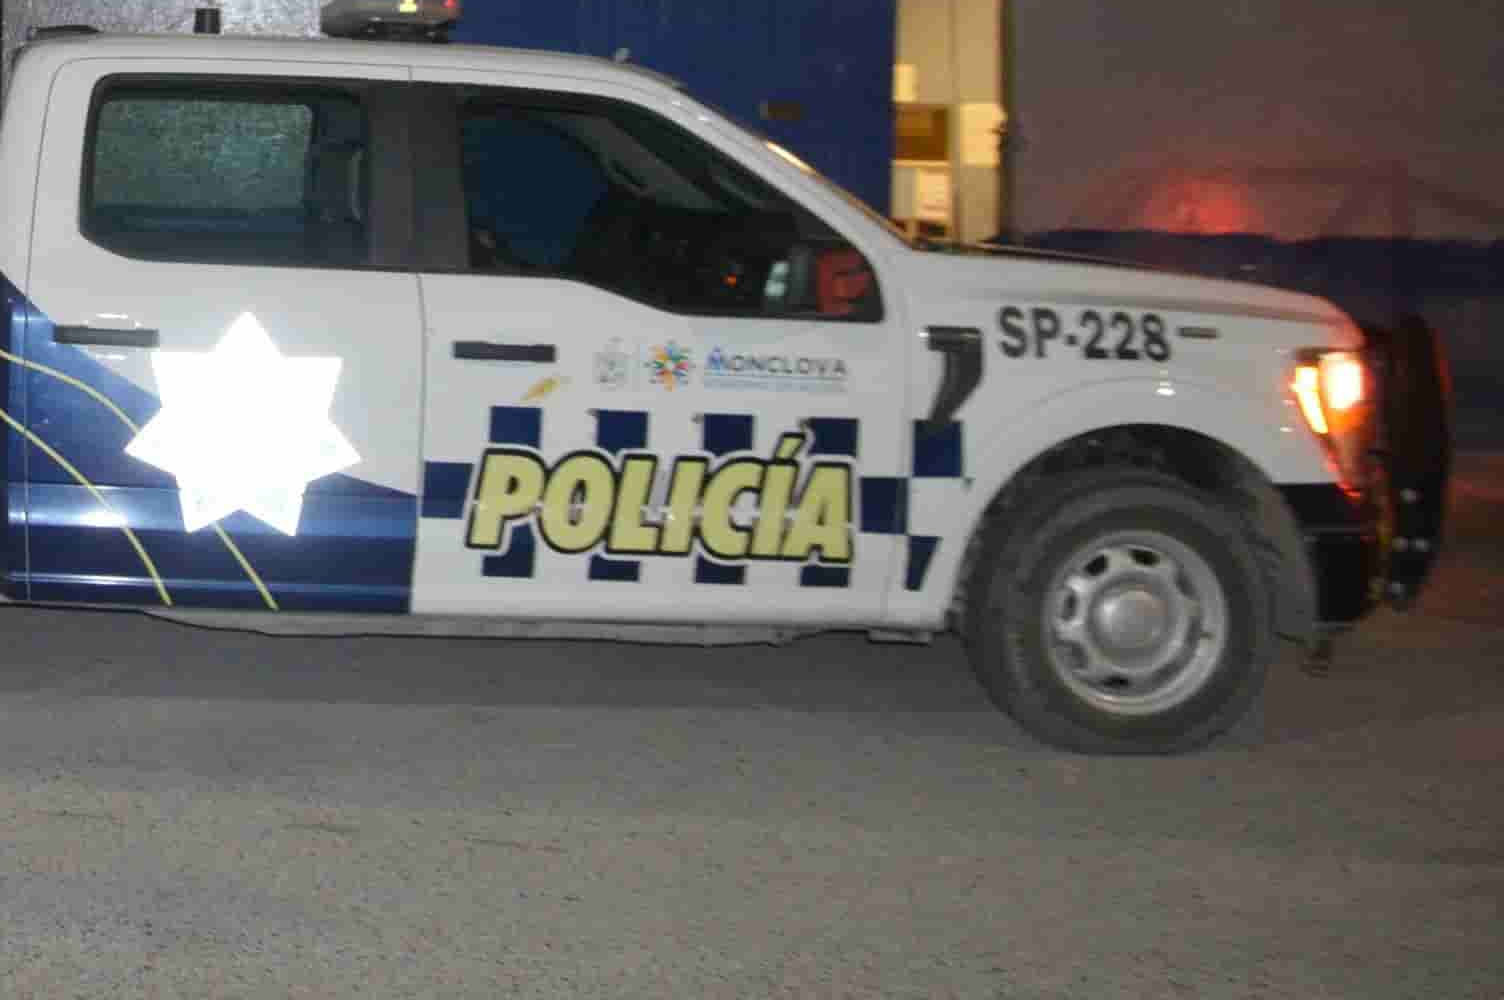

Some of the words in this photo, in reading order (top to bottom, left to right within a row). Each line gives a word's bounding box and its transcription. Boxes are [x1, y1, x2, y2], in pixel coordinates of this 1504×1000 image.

[704, 345, 848, 376] MONCLOVA
[999, 306, 1171, 362] SP-228
[466, 432, 853, 561] POLICÍA
